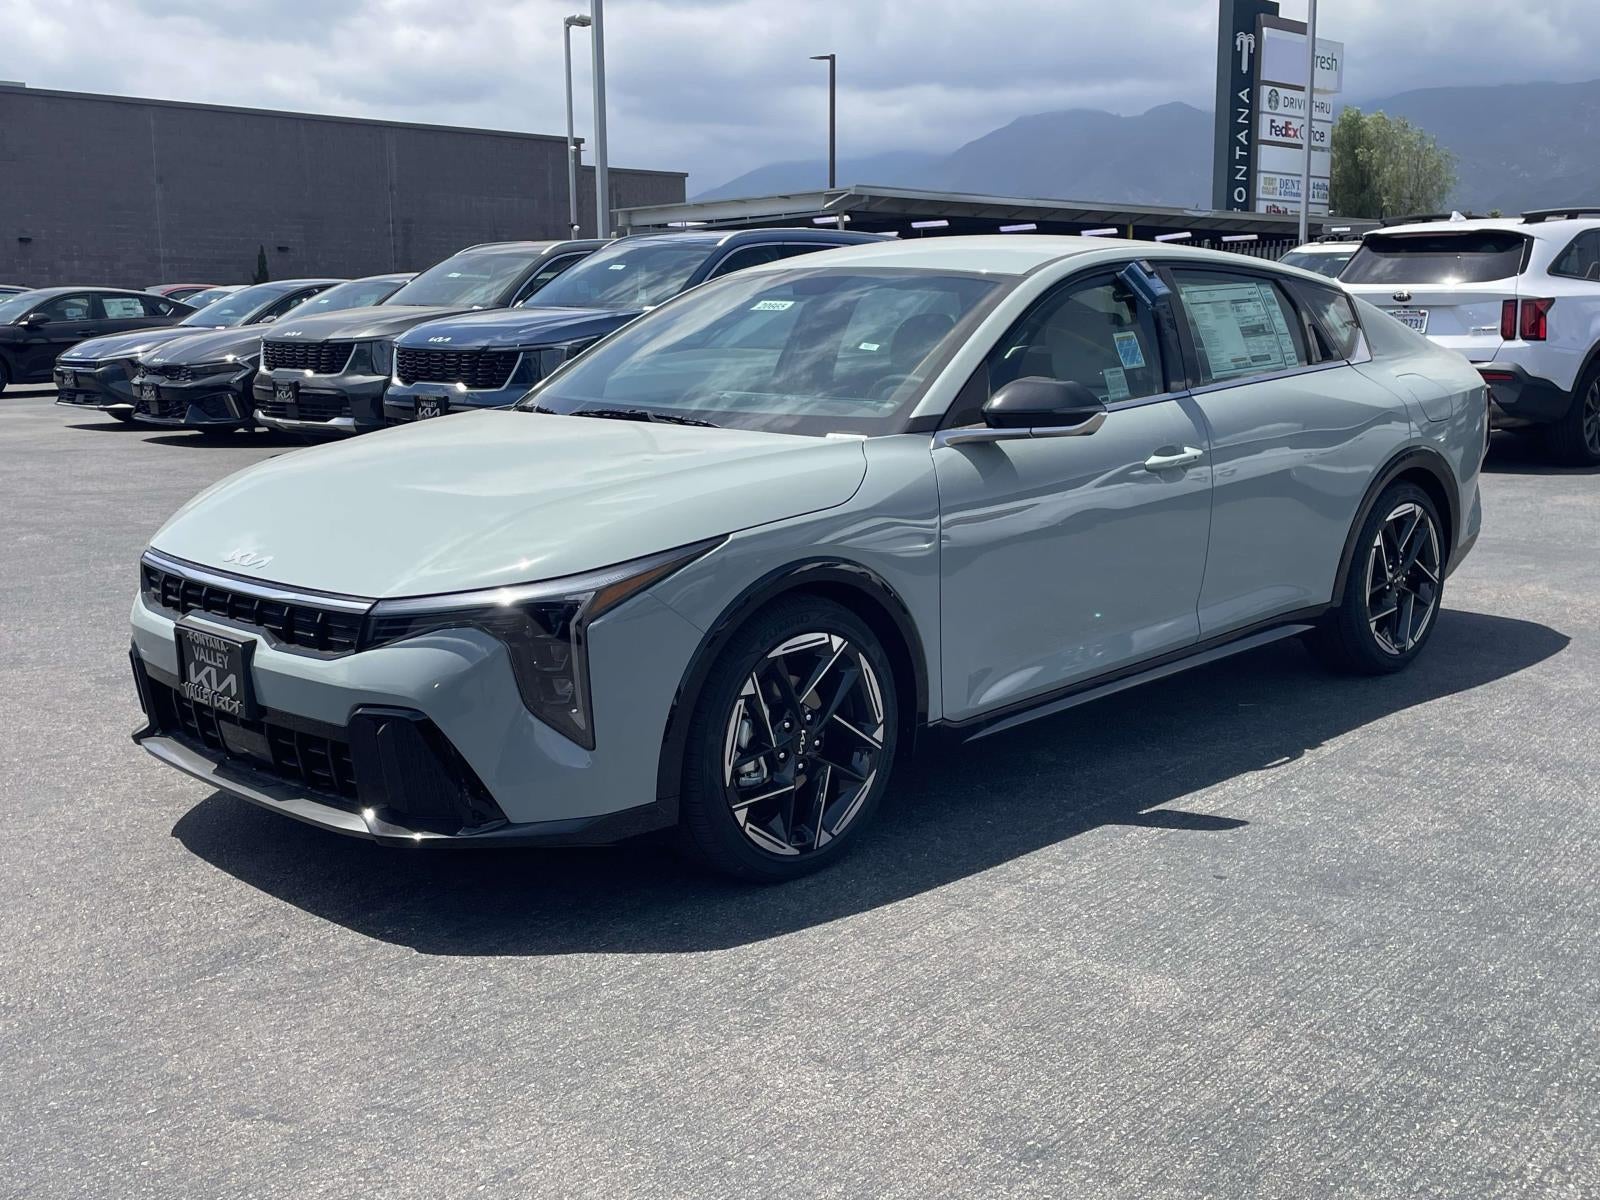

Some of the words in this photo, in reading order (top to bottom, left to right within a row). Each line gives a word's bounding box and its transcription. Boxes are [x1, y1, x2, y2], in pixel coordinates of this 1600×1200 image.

[1315, 52, 1338, 71] resh
[1283, 96, 1305, 110] DRIV
[1312, 100, 1331, 114] HRU
[1269, 119, 1299, 139] FedEx
[1233, 88, 1251, 212] ONTANA
[1280, 178, 1301, 191] DENT
[420, 401, 438, 409] VALLEY
[192, 645, 229, 669] VALLEY
[189, 661, 237, 698] KIA
